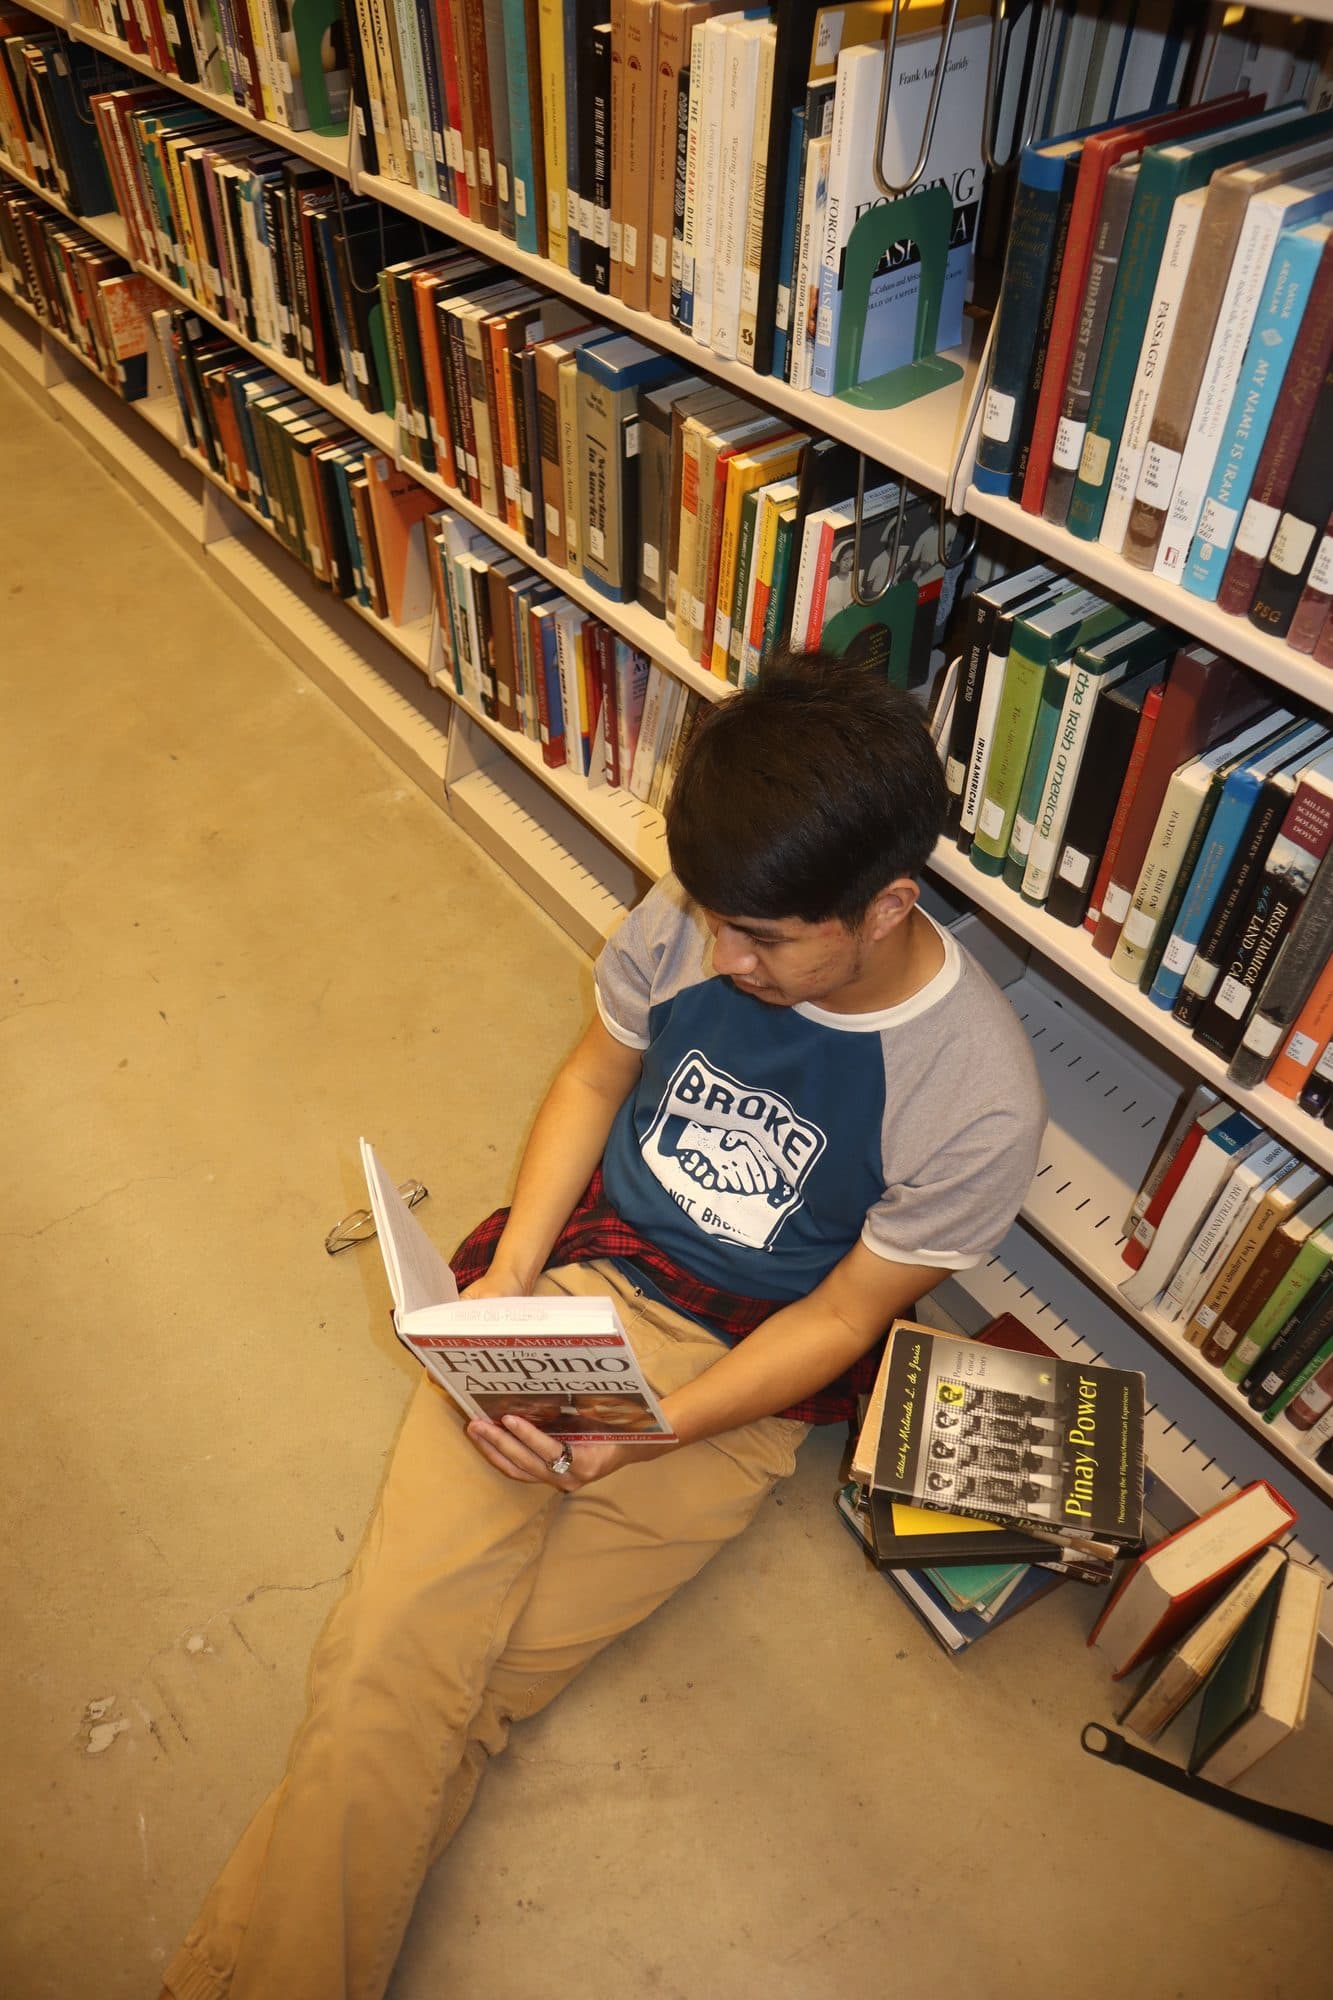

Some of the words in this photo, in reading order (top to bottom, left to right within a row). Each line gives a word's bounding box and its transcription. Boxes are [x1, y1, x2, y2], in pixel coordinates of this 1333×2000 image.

[899, 69, 920, 85] Frank
[688, 98, 700, 123] THE
[682, 127, 701, 204] IMMIGRANT
[682, 205, 697, 247] DIVIDE
[704, 215, 714, 248] Miami
[821, 195, 842, 266] FORGING
[1168, 222, 1188, 269] Howard
[1040, 286, 1057, 330] AMERICA
[1074, 261, 1106, 346] BUDAPEST
[792, 310, 807, 346] contra
[1142, 299, 1171, 379] PASSAGES
[1068, 349, 1088, 386] EXIT
[1249, 358, 1271, 391] MY
[1234, 388, 1262, 440] NAME
[1018, 453, 1029, 468] and
[1228, 441, 1246, 460] IS
[1215, 462, 1240, 503] IRAN
[735, 581, 743, 606] EUROPEAN
[1253, 602, 1281, 623] FSG
[966, 645, 981, 686] RAINBOW'S
[963, 685, 974, 702] END
[1070, 671, 1092, 707] the
[973, 736, 987, 763] IRISH
[964, 762, 983, 816] AMERICANS
[1303, 798, 1331, 818] MILLER
[1157, 808, 1182, 849] HAYDEN
[1292, 825, 1318, 845] DOYLE
[1141, 861, 1156, 882] THE
[1151, 868, 1169, 895] IRISH
[1131, 880, 1150, 912] INSIDE
[1146, 894, 1160, 910] ON
[1225, 886, 1241, 908] THE
[1212, 907, 1232, 938] IRISH
[1239, 912, 1265, 952] LAND
[1263, 900, 1289, 939] IRISH
[1241, 934, 1273, 988] IMMIGR
[675, 1065, 813, 1171] BROKE
[668, 1188, 697, 1214] NOT
[1227, 1182, 1243, 1202] ARE
[1208, 1197, 1235, 1234] ITALIANS
[426, 1337, 464, 1347] THE
[467, 1337, 509, 1347] NEW
[513, 1337, 614, 1347] AMERICANS
[508, 1350, 538, 1359] The
[906, 1342, 926, 1372] Jesús
[430, 1350, 631, 1380] Filipino
[905, 1370, 918, 1384] de
[464, 1375, 640, 1392] Americans
[1068, 1375, 1098, 1446] Power
[1120, 1385, 1132, 1420] Experience
[897, 1399, 914, 1442] Melinda
[898, 1441, 912, 1454] by
[894, 1452, 908, 1480] Edited
[1118, 1475, 1127, 1488] the
[1065, 1452, 1099, 1517] Pinay
[1116, 1487, 1128, 1524] Theorizing
